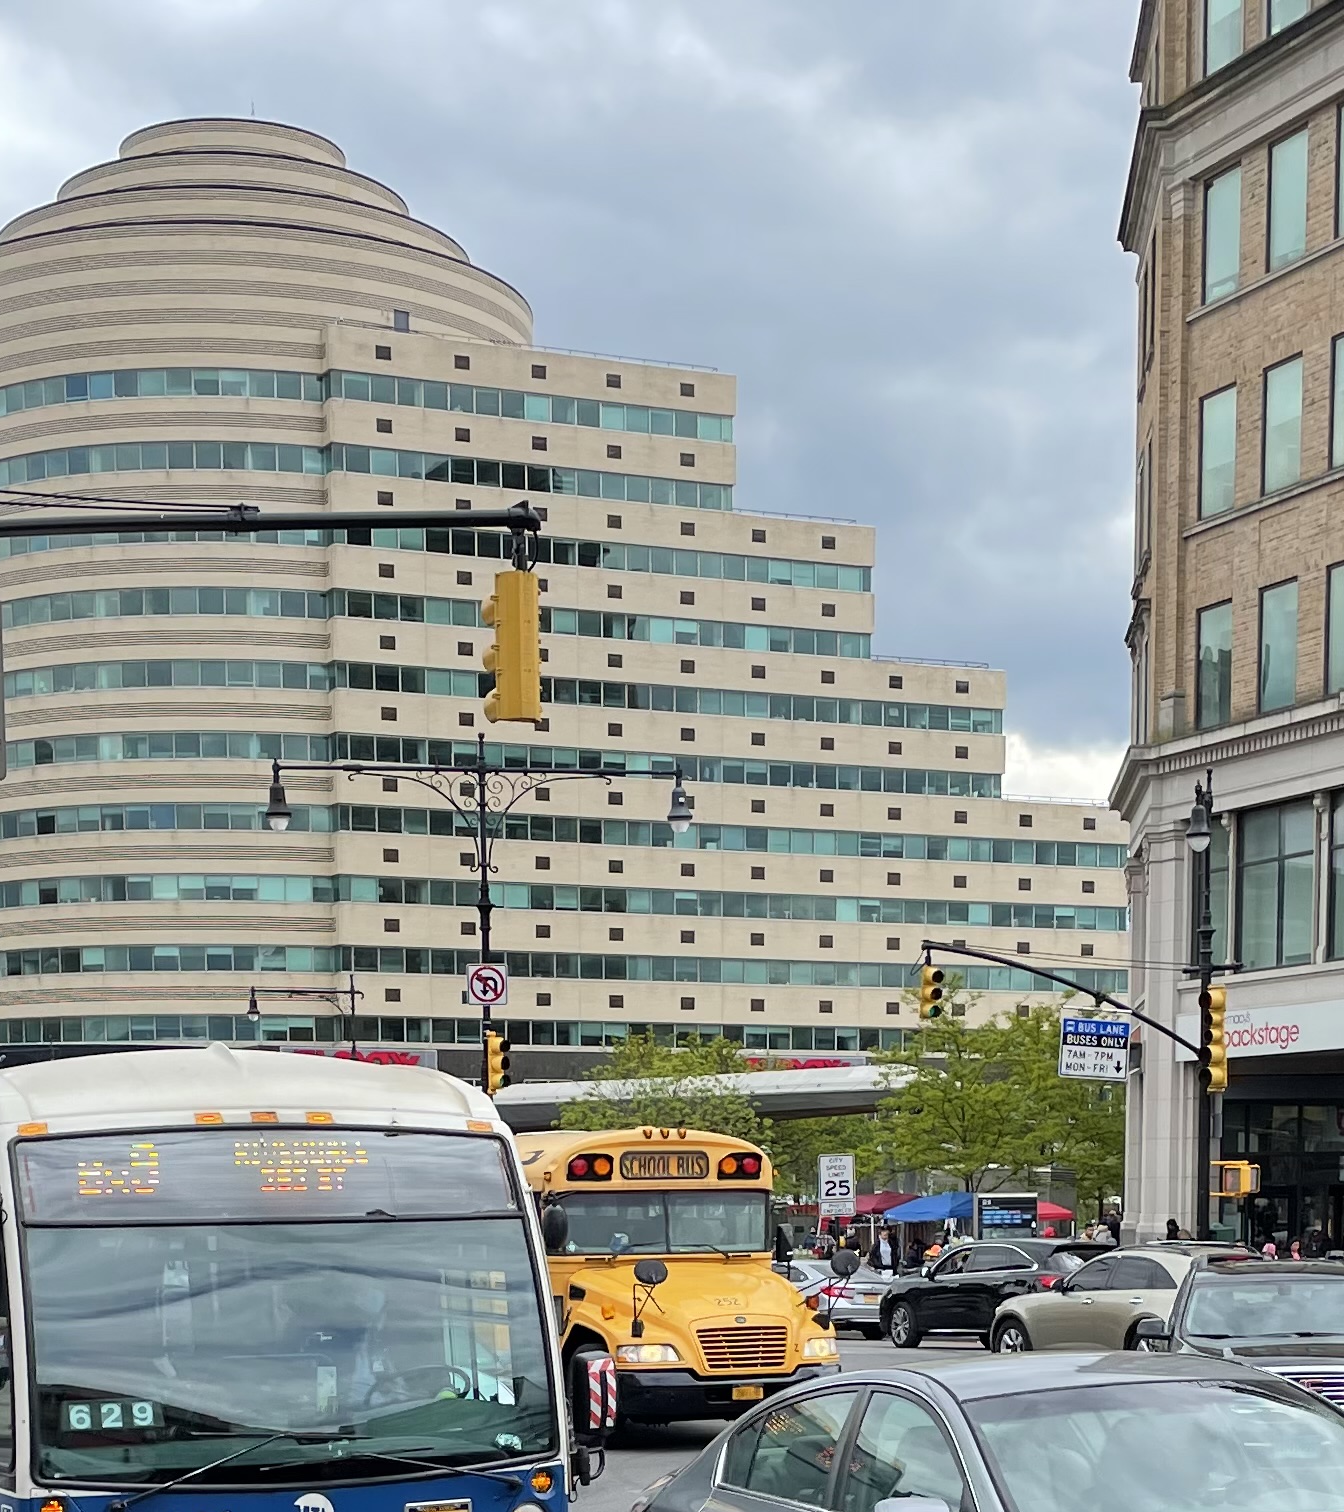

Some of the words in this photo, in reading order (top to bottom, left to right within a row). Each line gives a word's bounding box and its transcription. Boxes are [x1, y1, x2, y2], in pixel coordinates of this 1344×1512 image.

[1078, 1022, 1097, 1033] BUS
[1100, 1024, 1126, 1035] LANE
[1066, 1034, 1098, 1046] BUSES
[1101, 1036, 1126, 1047] ONLY
[622, 1156, 672, 1176] SCHOOL
[677, 1156, 704, 1176] BUS
[825, 1180, 850, 1196] 25
[69, 1402, 155, 1430] 629
